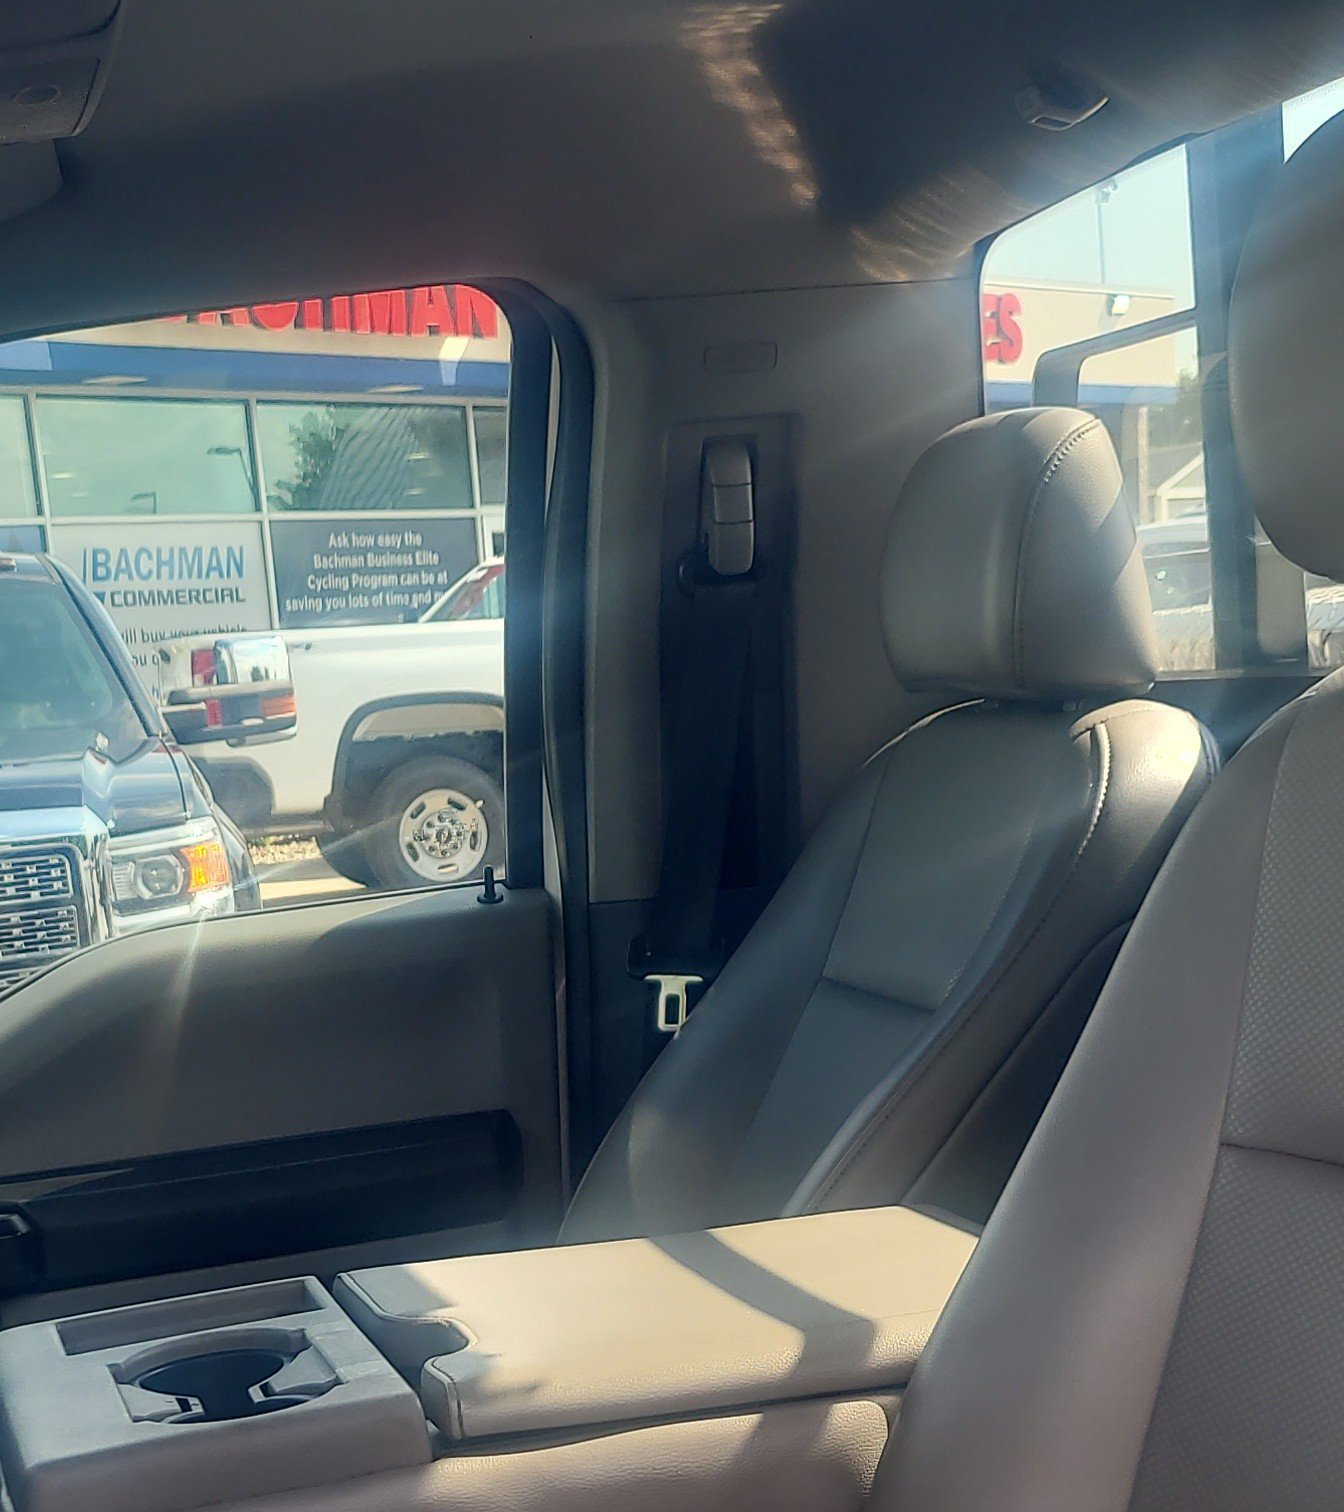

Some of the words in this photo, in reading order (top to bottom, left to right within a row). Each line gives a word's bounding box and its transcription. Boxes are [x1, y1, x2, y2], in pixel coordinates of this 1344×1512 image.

[328, 532, 349, 549] Ask
[352, 532, 375, 548] how
[377, 533, 403, 550] easy
[404, 531, 423, 547] the
[92, 545, 245, 582] BACHMAN
[313, 553, 365, 569] Bachman
[367, 551, 413, 568] Business
[415, 550, 440, 566] Elite
[307, 573, 349, 593] Cycling
[352, 572, 398, 590] Program
[400, 572, 420, 586] can
[421, 571, 435, 586] be
[110, 586, 247, 608] COMMERCIAL
[285, 595, 323, 613] saving
[325, 595, 347, 611] you
[349, 593, 369, 609] lots
[372, 592, 383, 607] of
[386, 592, 408, 606] time
